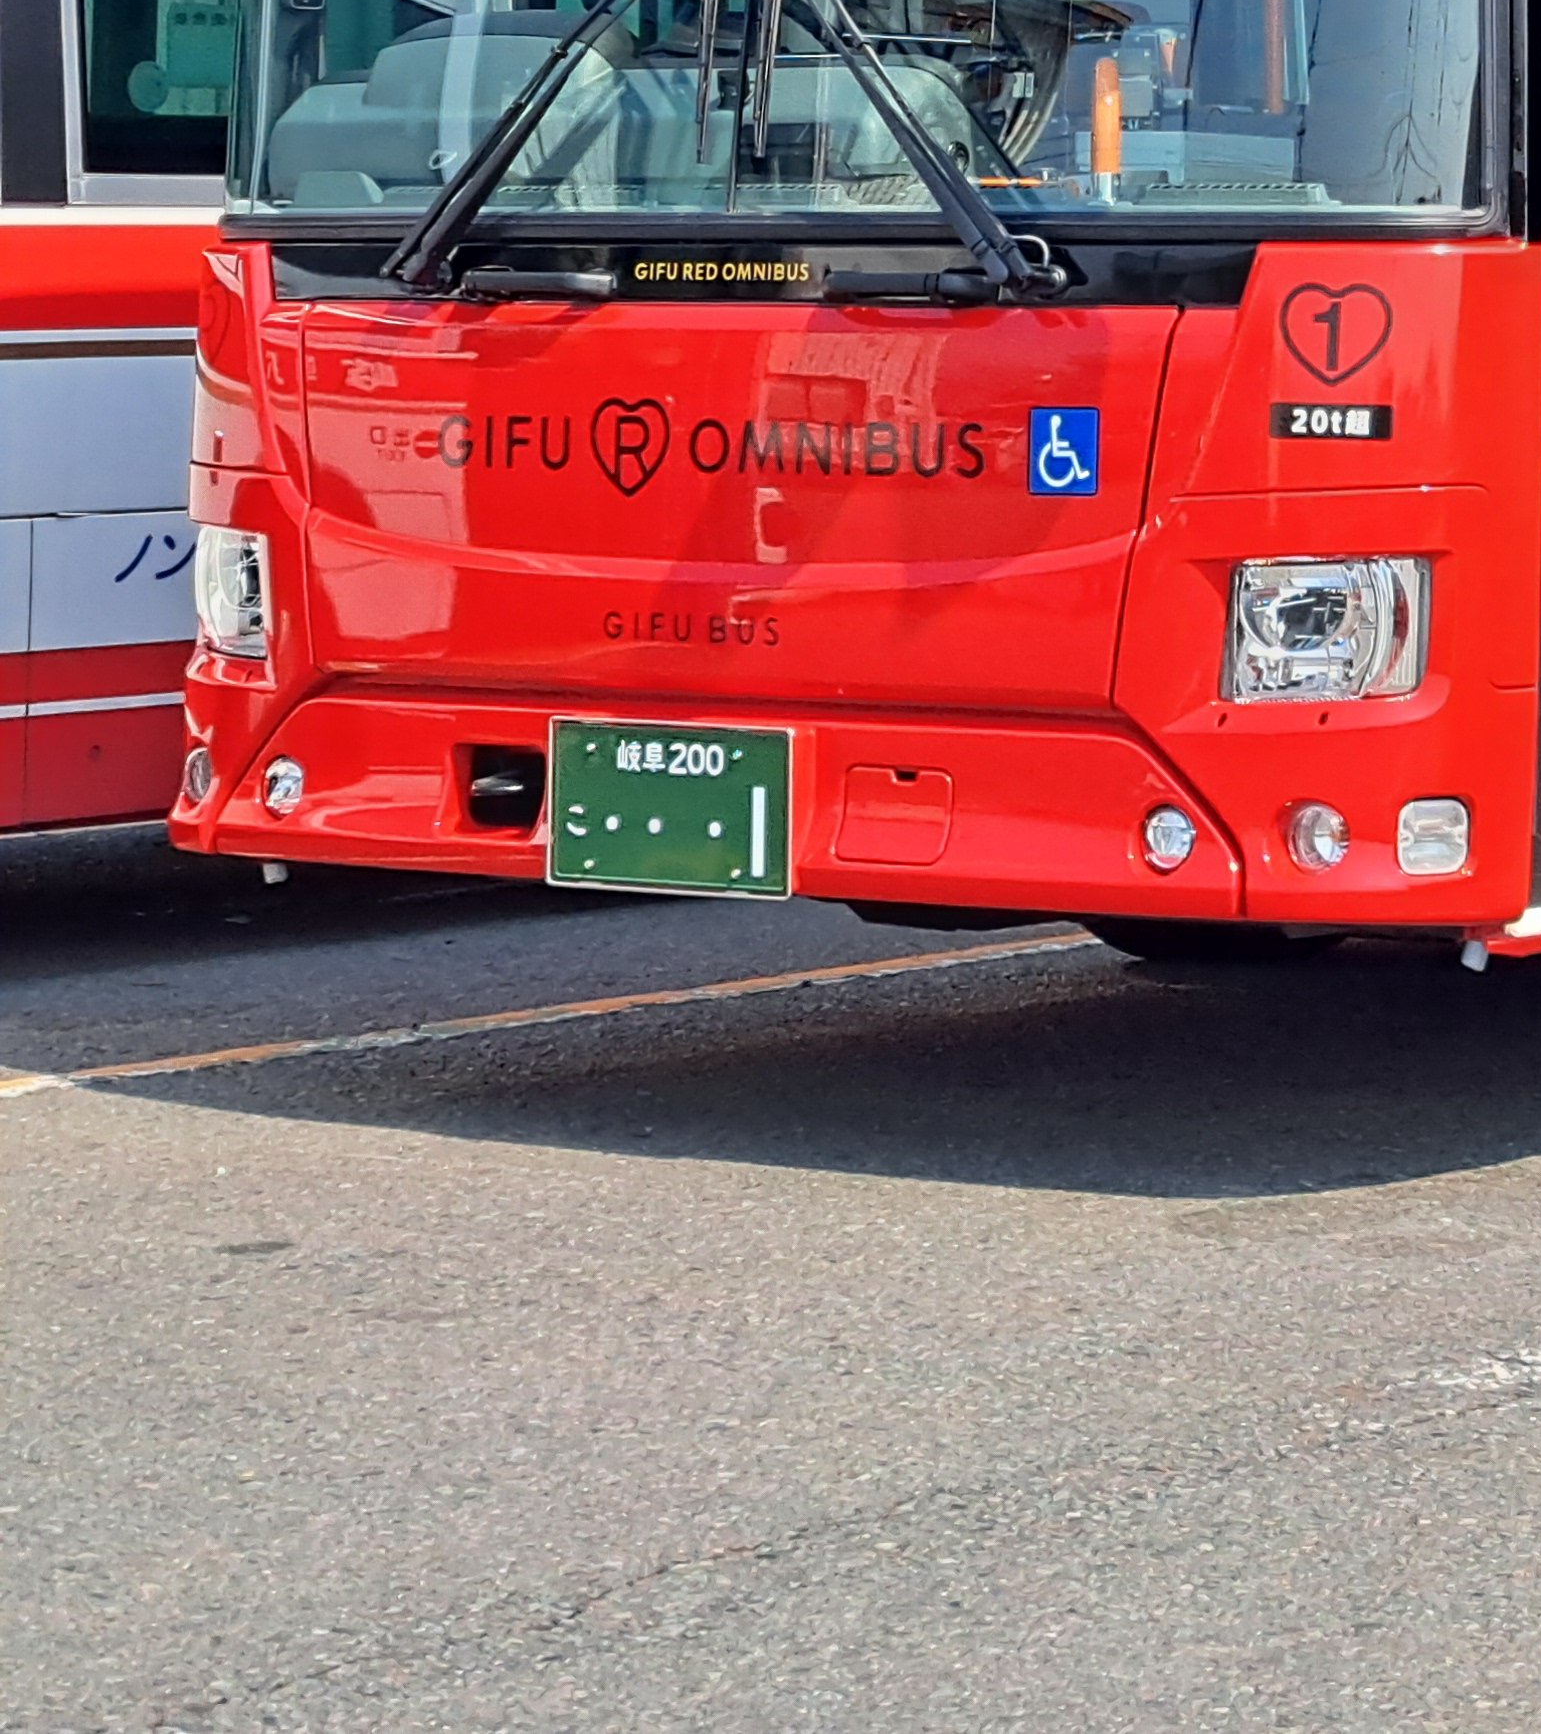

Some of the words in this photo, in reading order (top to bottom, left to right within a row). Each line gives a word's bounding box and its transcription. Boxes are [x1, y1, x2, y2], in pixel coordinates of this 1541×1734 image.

[633, 260, 679, 282] GIFU
[681, 261, 719, 283] RED
[721, 262, 810, 283] OMNIBUS
[1313, 300, 1341, 372] 1
[436, 414, 572, 472] GIFU
[688, 417, 987, 480] OMNIBUS
[602, 610, 693, 643] GIFU
[707, 614, 782, 647] BUS
